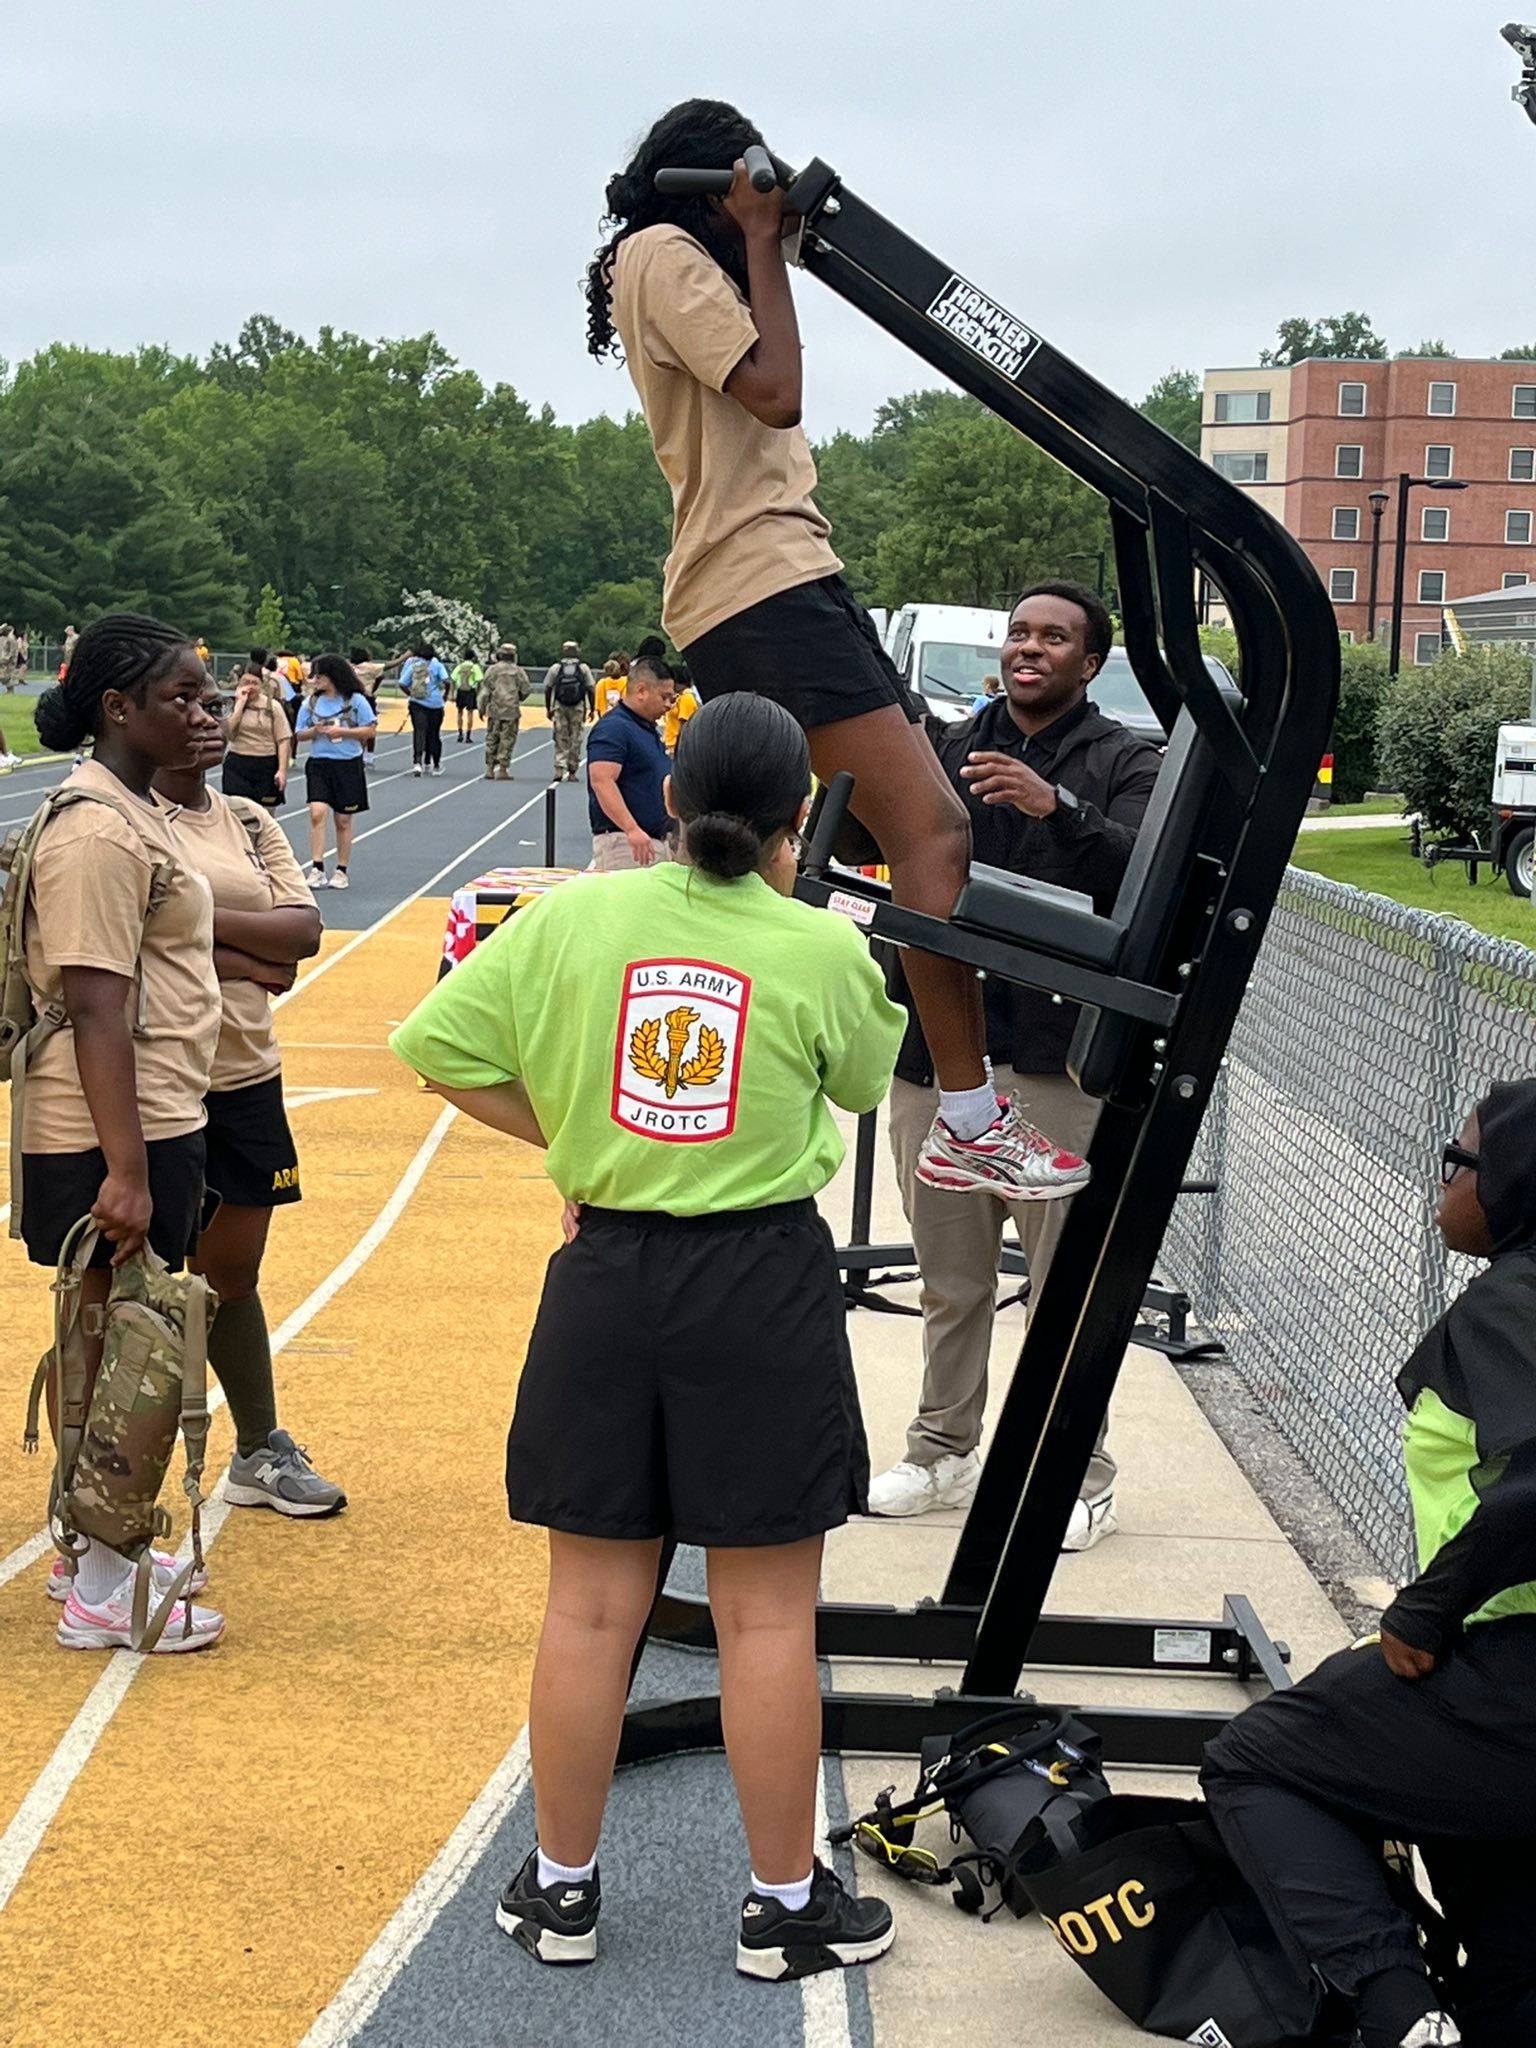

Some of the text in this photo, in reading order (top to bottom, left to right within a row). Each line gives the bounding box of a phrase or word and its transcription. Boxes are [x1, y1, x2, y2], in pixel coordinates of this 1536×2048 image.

[933, 299, 1022, 374] STRENGTH
[949, 283, 1030, 353] HAMMER
[636, 970, 738, 997] U.S. ARMY
[630, 1107, 708, 1131] JROTC
